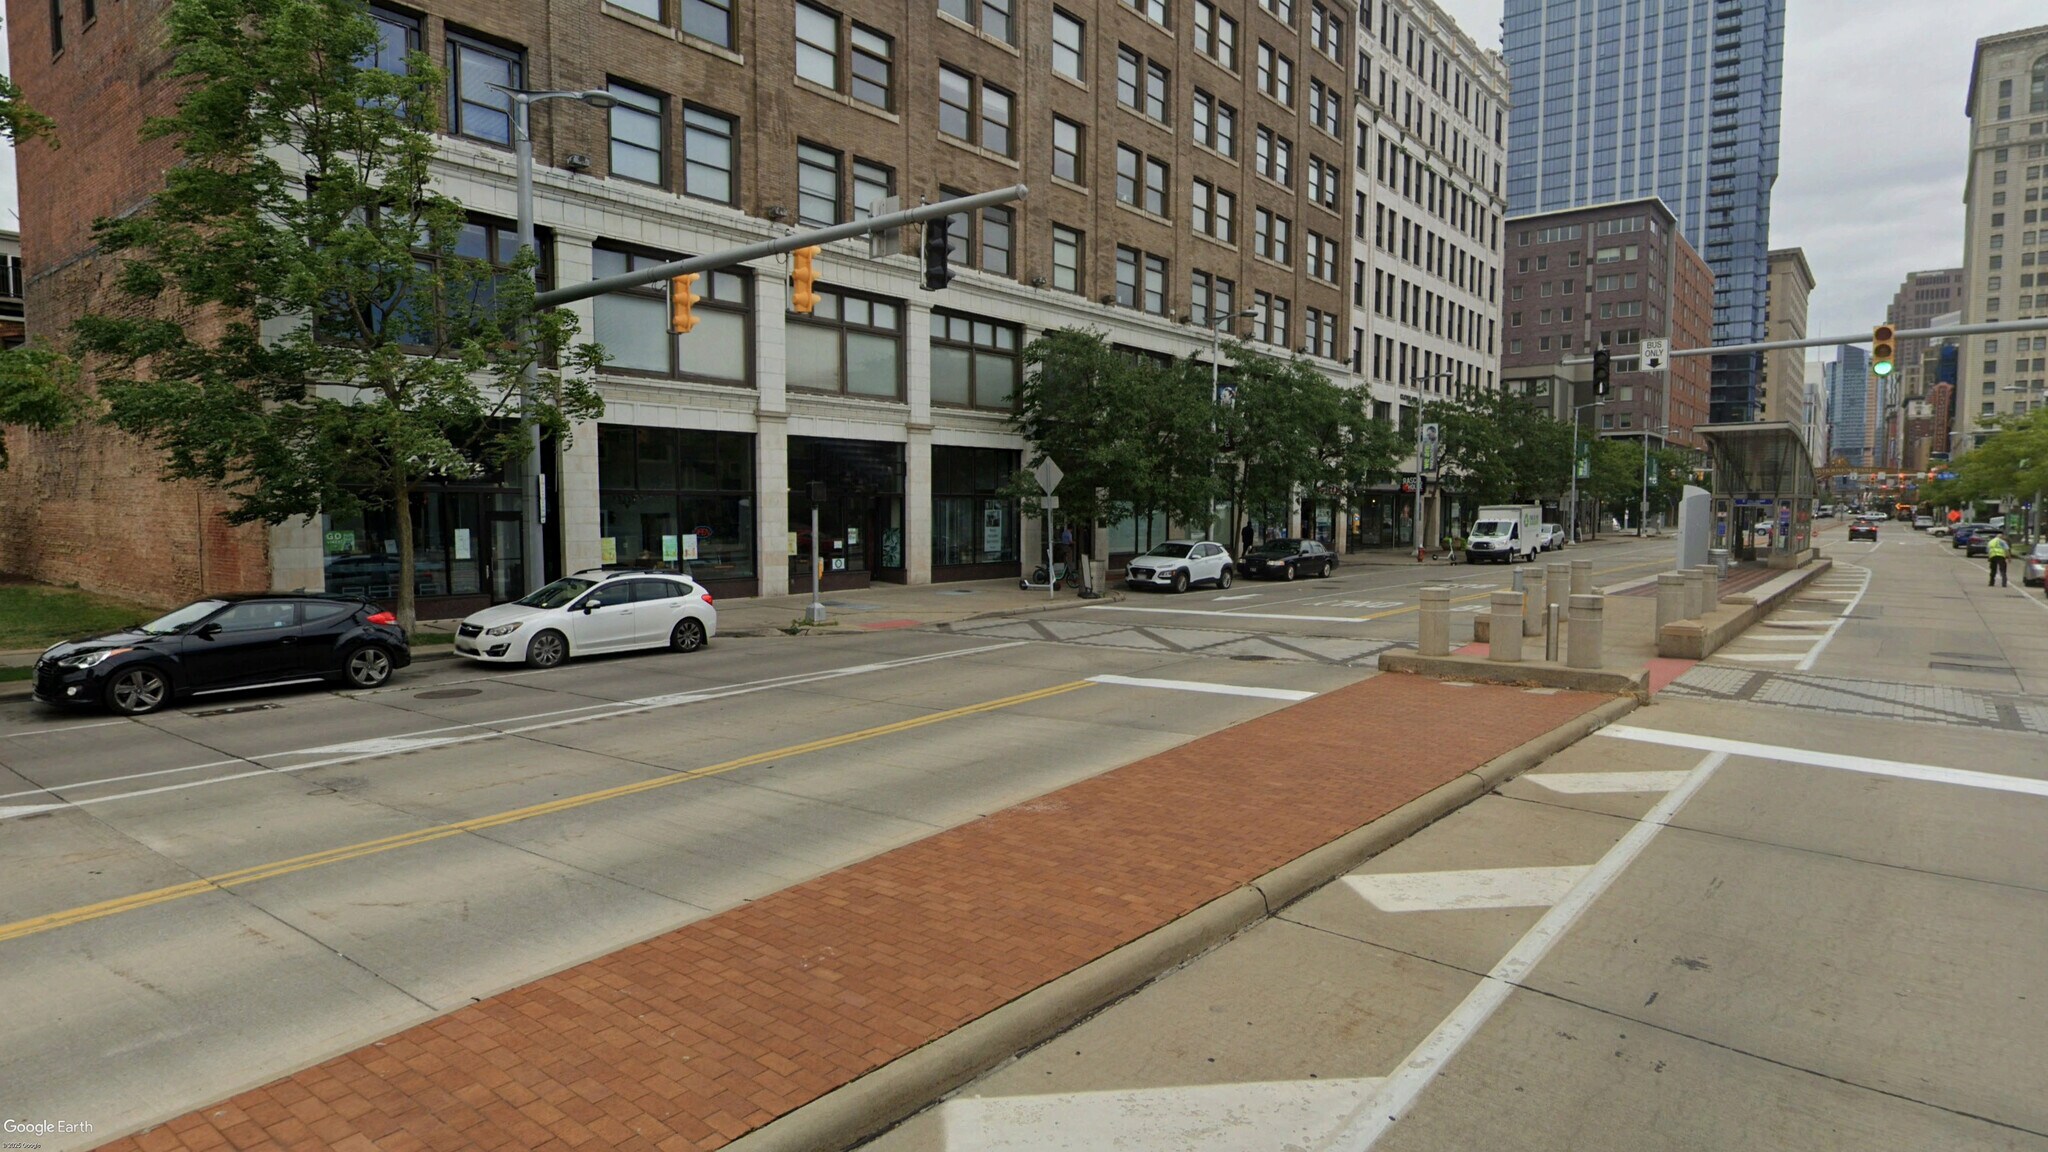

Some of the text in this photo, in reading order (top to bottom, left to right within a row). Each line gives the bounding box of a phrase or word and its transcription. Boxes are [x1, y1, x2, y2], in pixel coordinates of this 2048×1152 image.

[1647, 341, 1662, 349] BUS
[1645, 349, 1664, 357] ONLY
[326, 532, 342, 540] GO
